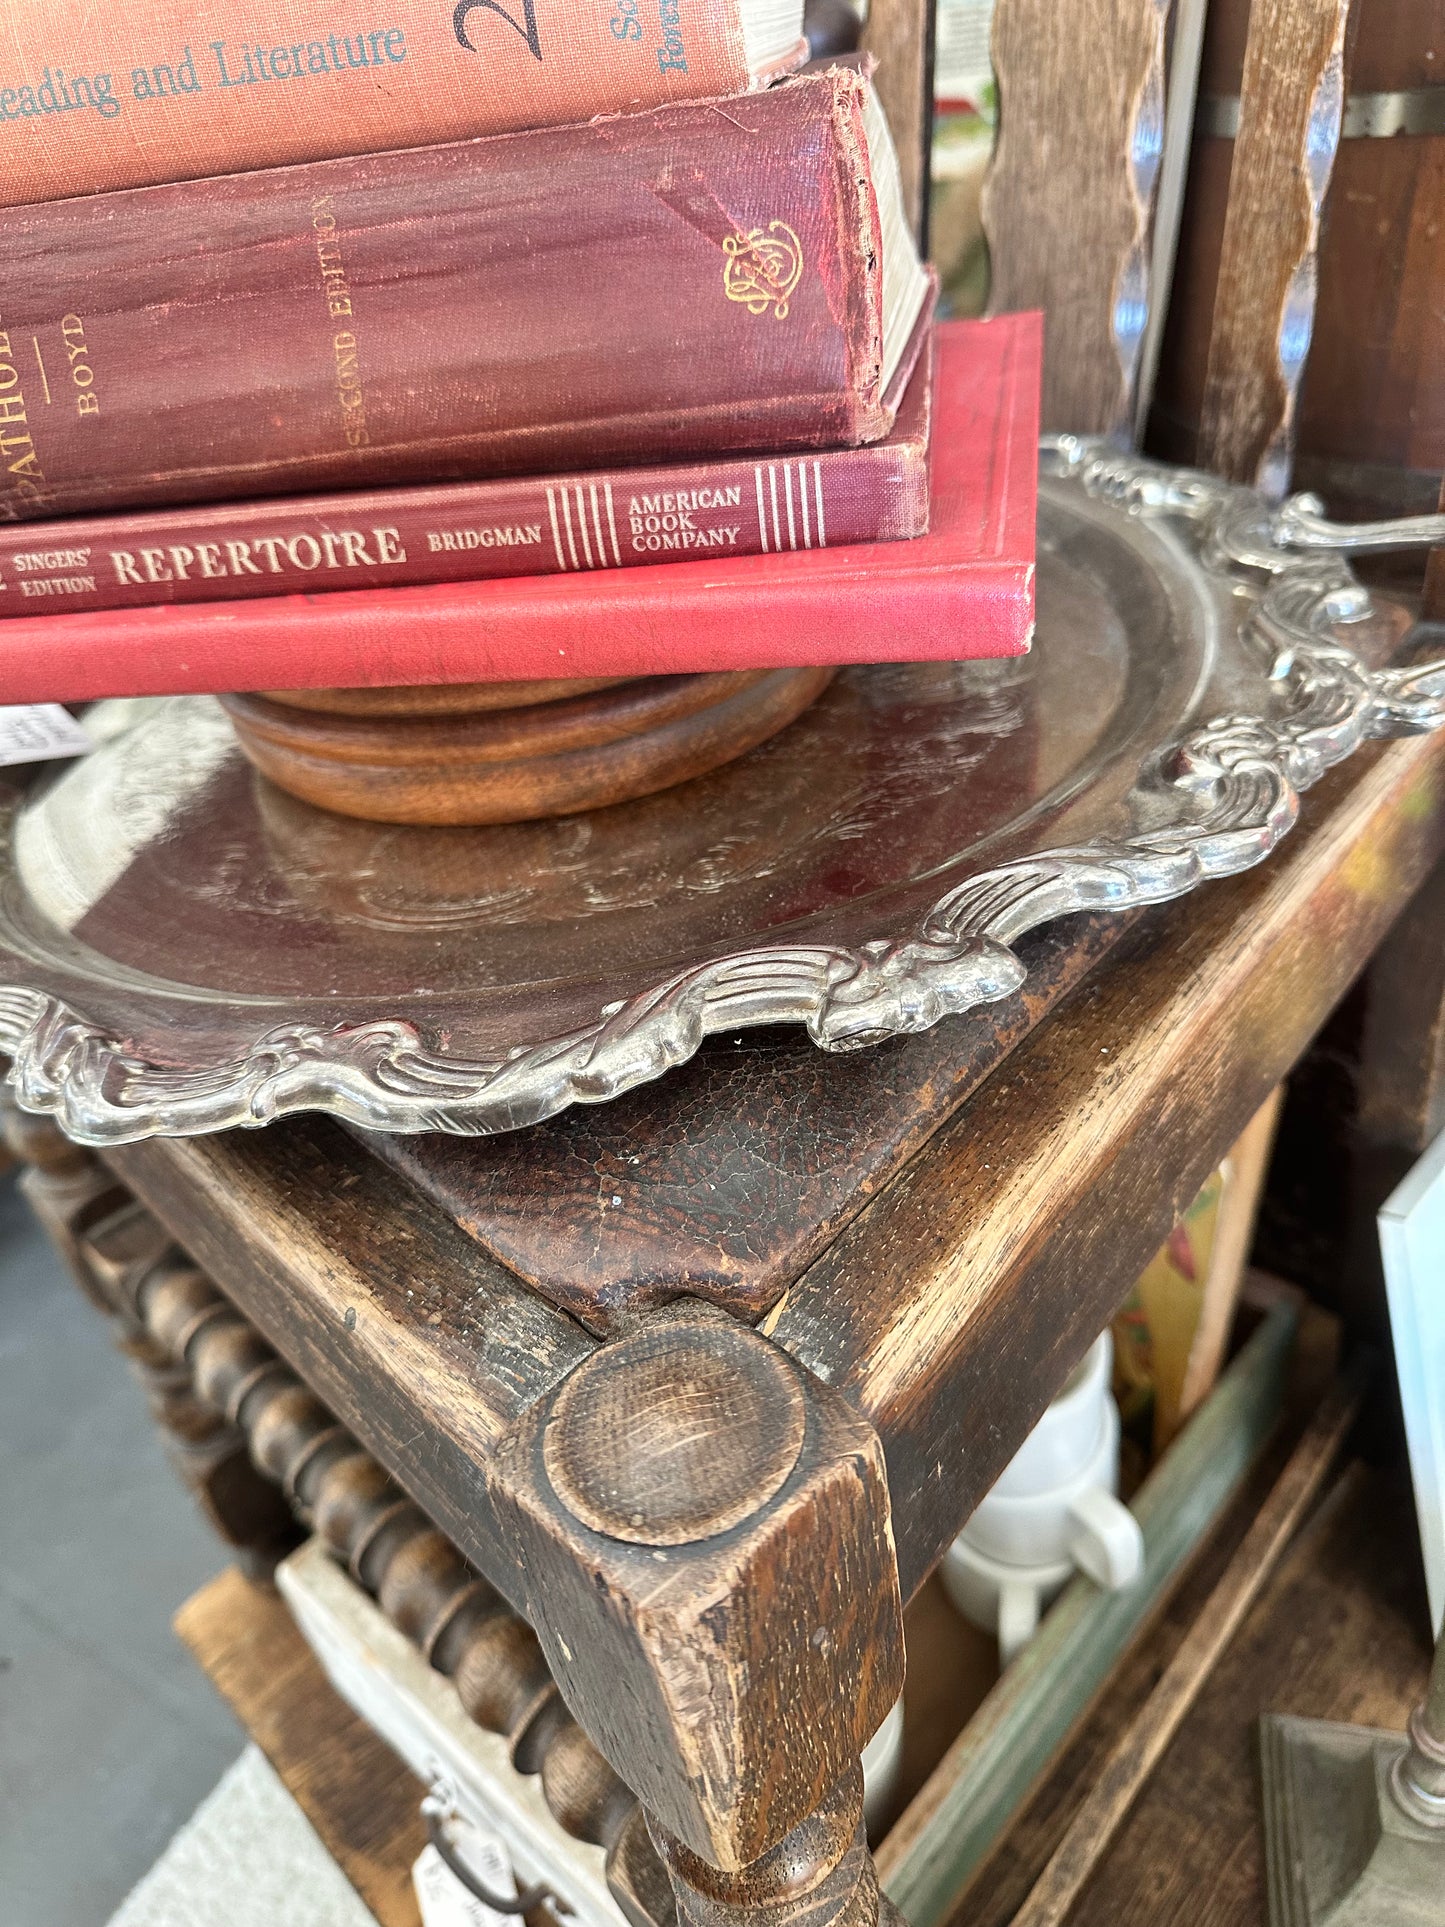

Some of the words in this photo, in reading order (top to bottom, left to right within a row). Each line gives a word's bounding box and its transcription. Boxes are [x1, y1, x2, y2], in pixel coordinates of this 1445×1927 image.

[453, 0, 543, 61] 2
[0, 66, 120, 120] eading
[131, 46, 201, 100] and
[209, 27, 407, 88] Literature
[61, 312, 101, 417] BOYD
[334, 331, 370, 446] SECOND
[628, 486, 741, 516] AMERICAN
[629, 511, 698, 535] BOOK
[109, 527, 407, 585] REPERTOIRE
[427, 525, 543, 553] BRIDGMAN
[631, 527, 741, 553] COMPANY
[21, 576, 98, 597] EDITION
